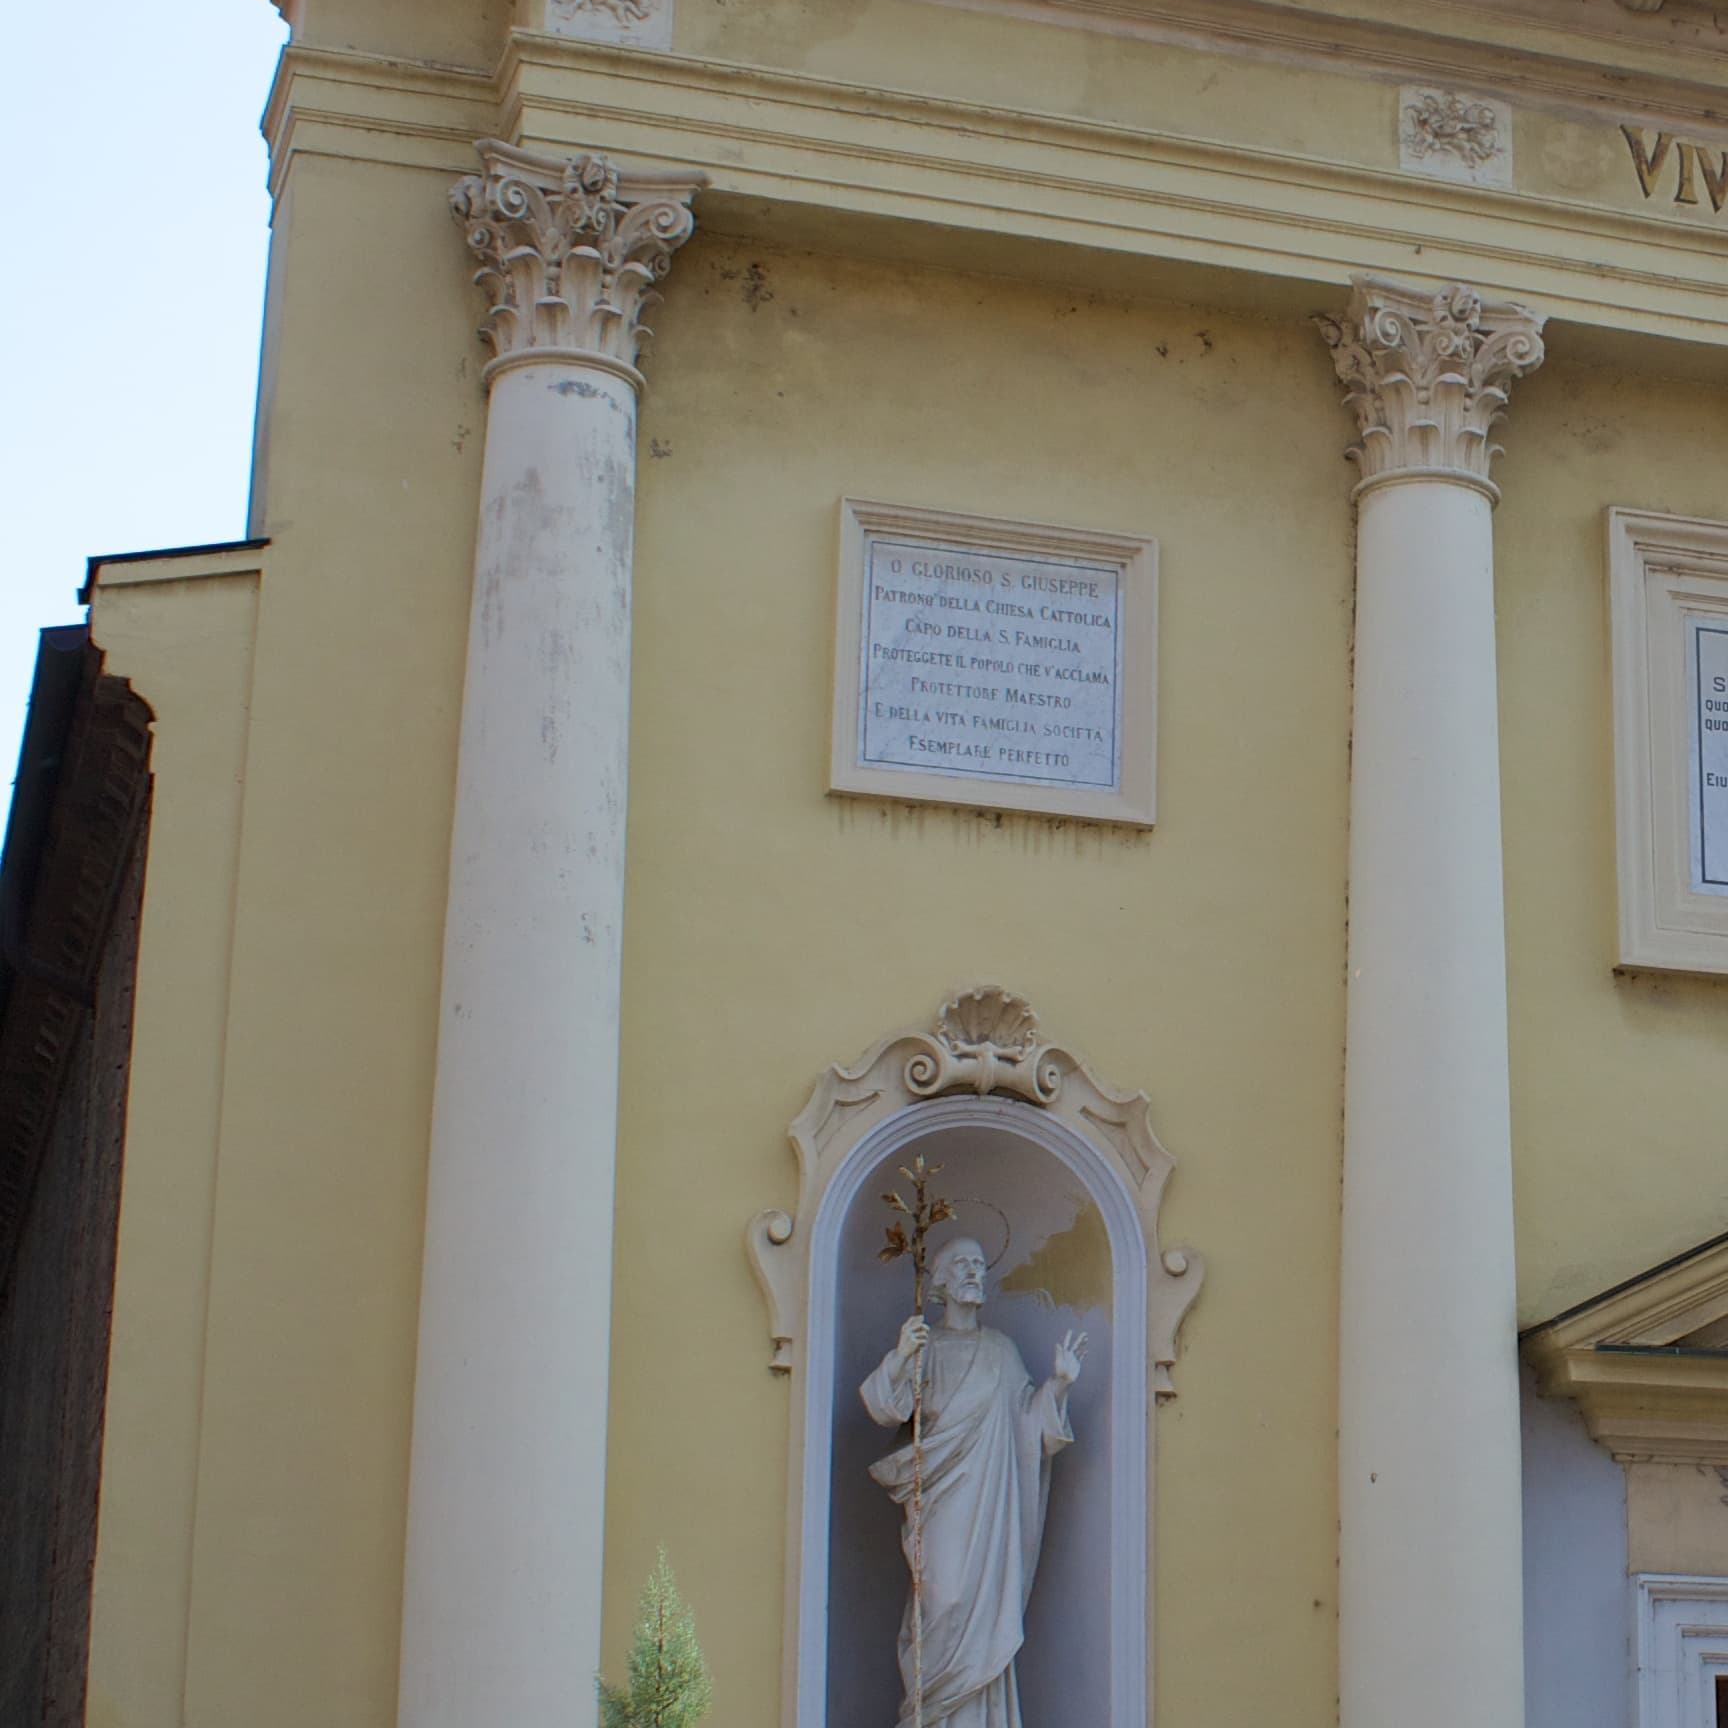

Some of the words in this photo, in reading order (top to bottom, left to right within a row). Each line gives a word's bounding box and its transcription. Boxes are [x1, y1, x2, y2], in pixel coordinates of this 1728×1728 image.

[891, 559, 902, 574] O
[911, 561, 993, 585] GLORIOSO
[1021, 574, 1099, 599] GIUSEPPE
[875, 584, 934, 607] PATRONO
[940, 595, 981, 612] DELLA
[985, 599, 1035, 620] CHIESA
[1040, 605, 1112, 629] CATTOLICA
[905, 617, 942, 636] CAPO
[947, 625, 993, 642] DELLA
[1015, 630, 1081, 654] FAMIGLIA
[873, 643, 953, 668] PROTEGGETE
[955, 655, 968, 669] IL
[970, 657, 1014, 673] POPOLO
[1017, 662, 1041, 678] CHE
[911, 676, 1000, 701] PROTETTORE
[1005, 687, 1072, 709] MAESTRO
[874, 701, 884, 718] E
[889, 706, 931, 723] DELLA
[935, 711, 967, 727] VITA
[972, 715, 1037, 736] FAMIGLIA
[909, 735, 992, 759] ESEMPLARE
[999, 747, 1070, 768] PERFETTO
